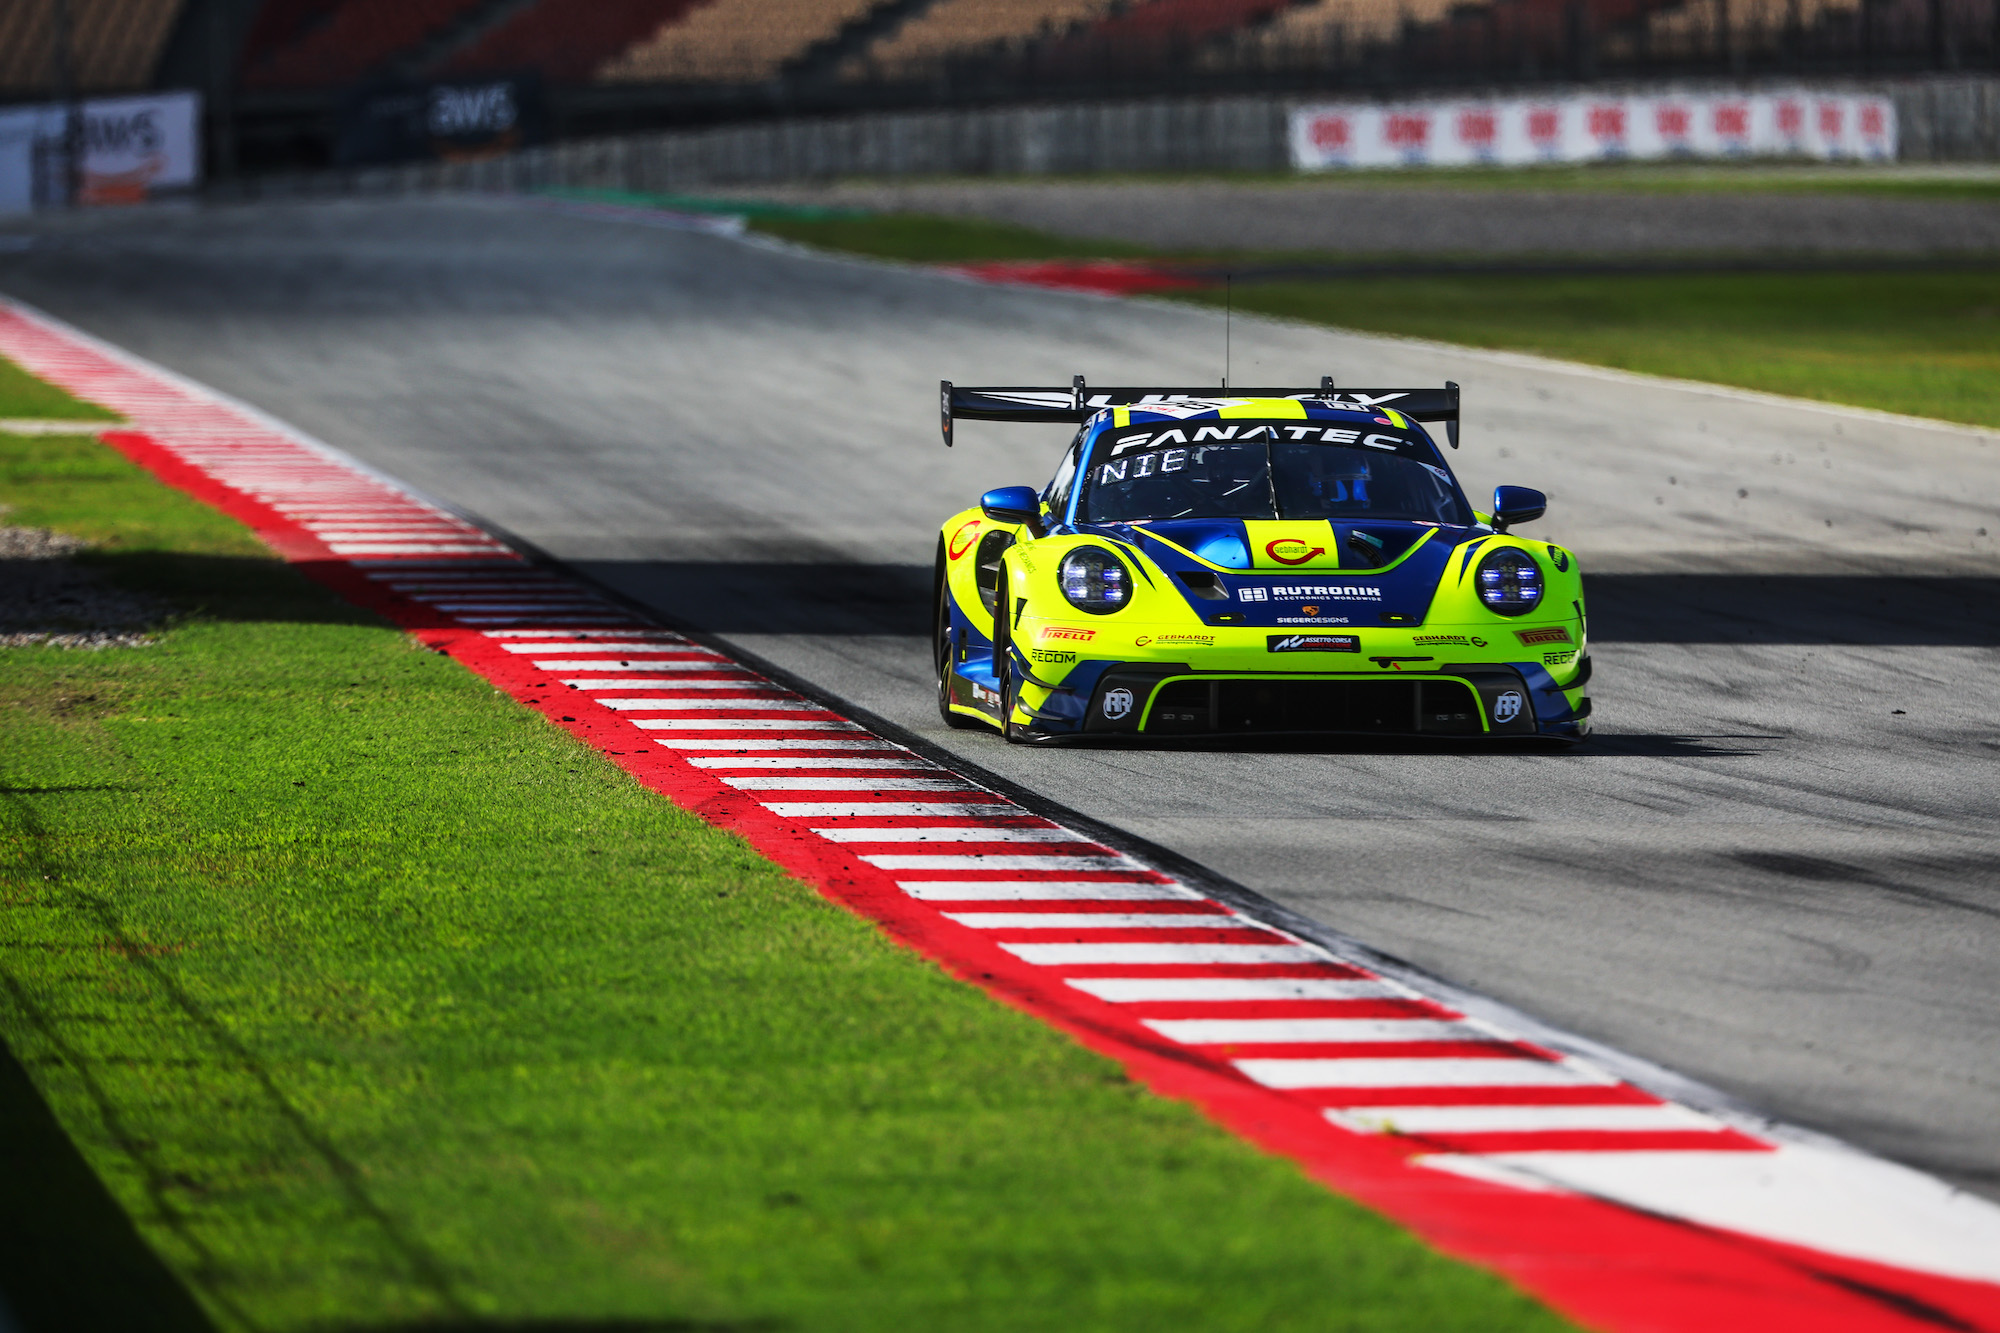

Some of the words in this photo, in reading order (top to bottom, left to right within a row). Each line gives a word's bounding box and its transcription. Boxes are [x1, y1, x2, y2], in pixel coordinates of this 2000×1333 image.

[1110, 425, 1404, 457] FANATEC
[1101, 448, 1186, 485] NIE
[1272, 586, 1382, 596] RUTRONIK
[1041, 627, 1096, 642] PIRELLI
[1519, 629, 1569, 644] PIRELLI
[1031, 651, 1076, 664] RECOM
